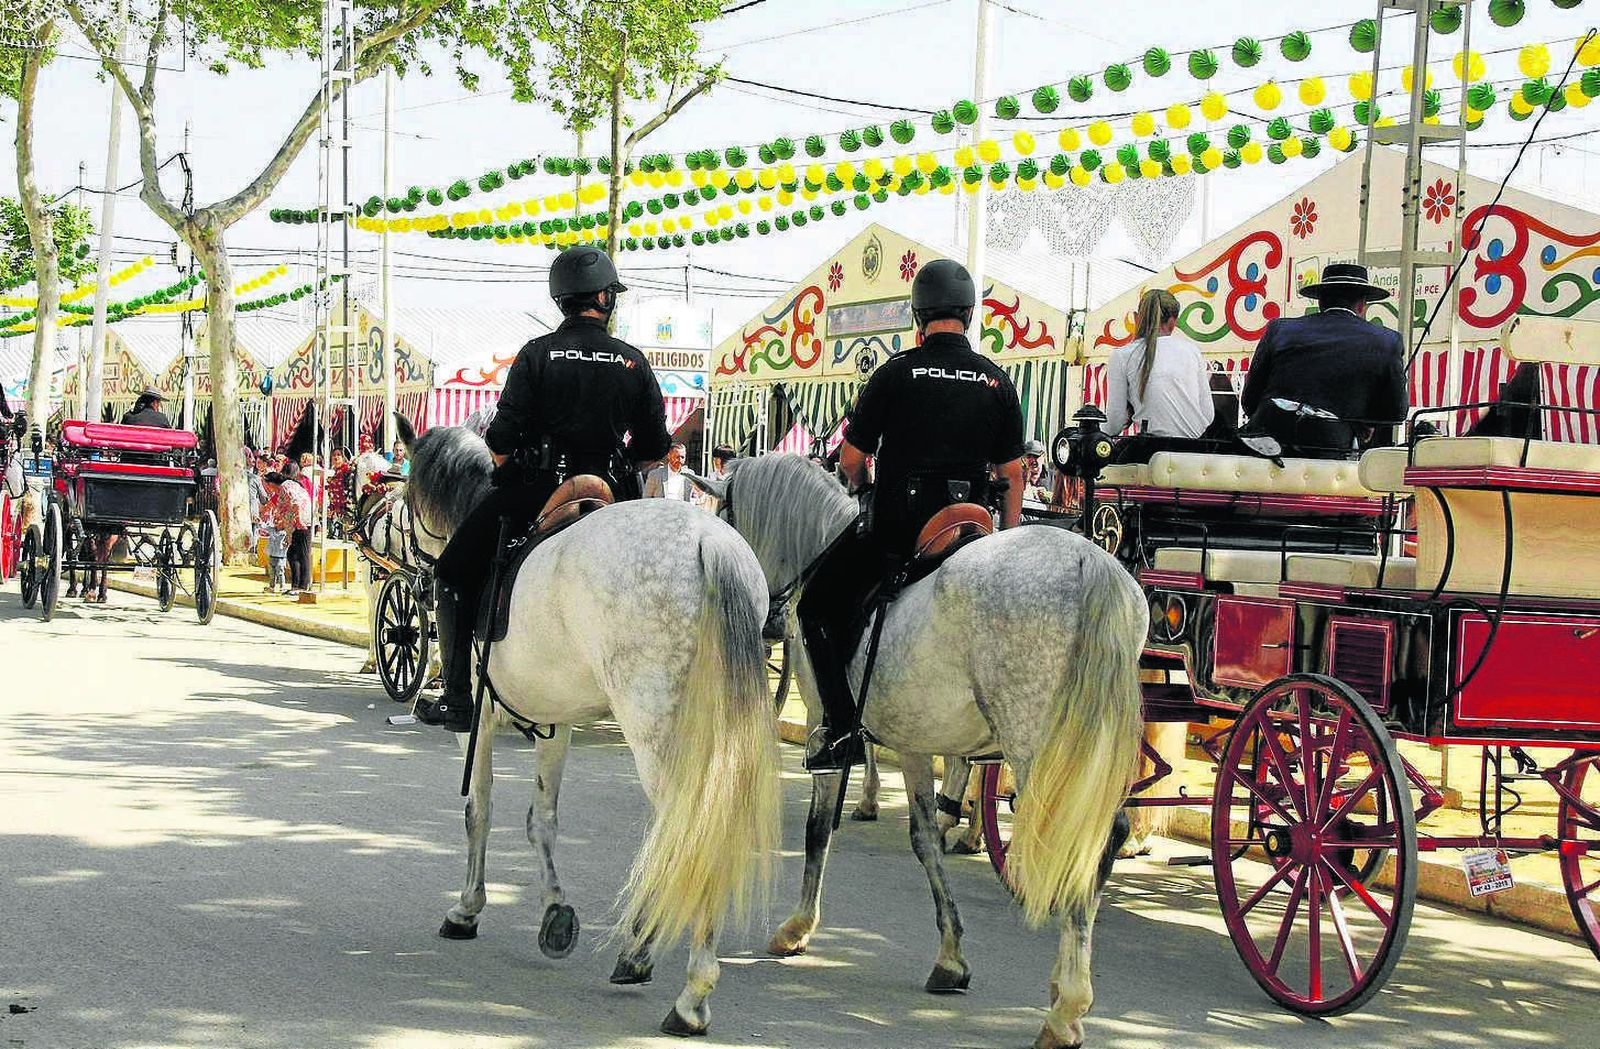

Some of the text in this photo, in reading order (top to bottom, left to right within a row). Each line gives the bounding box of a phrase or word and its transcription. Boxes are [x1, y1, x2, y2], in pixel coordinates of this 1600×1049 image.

[1424, 284, 1440, 295] PCE
[550, 350, 626, 365] POLICIA
[647, 351, 704, 369] AFLIGIDOS
[912, 367, 989, 385] POLICIA
